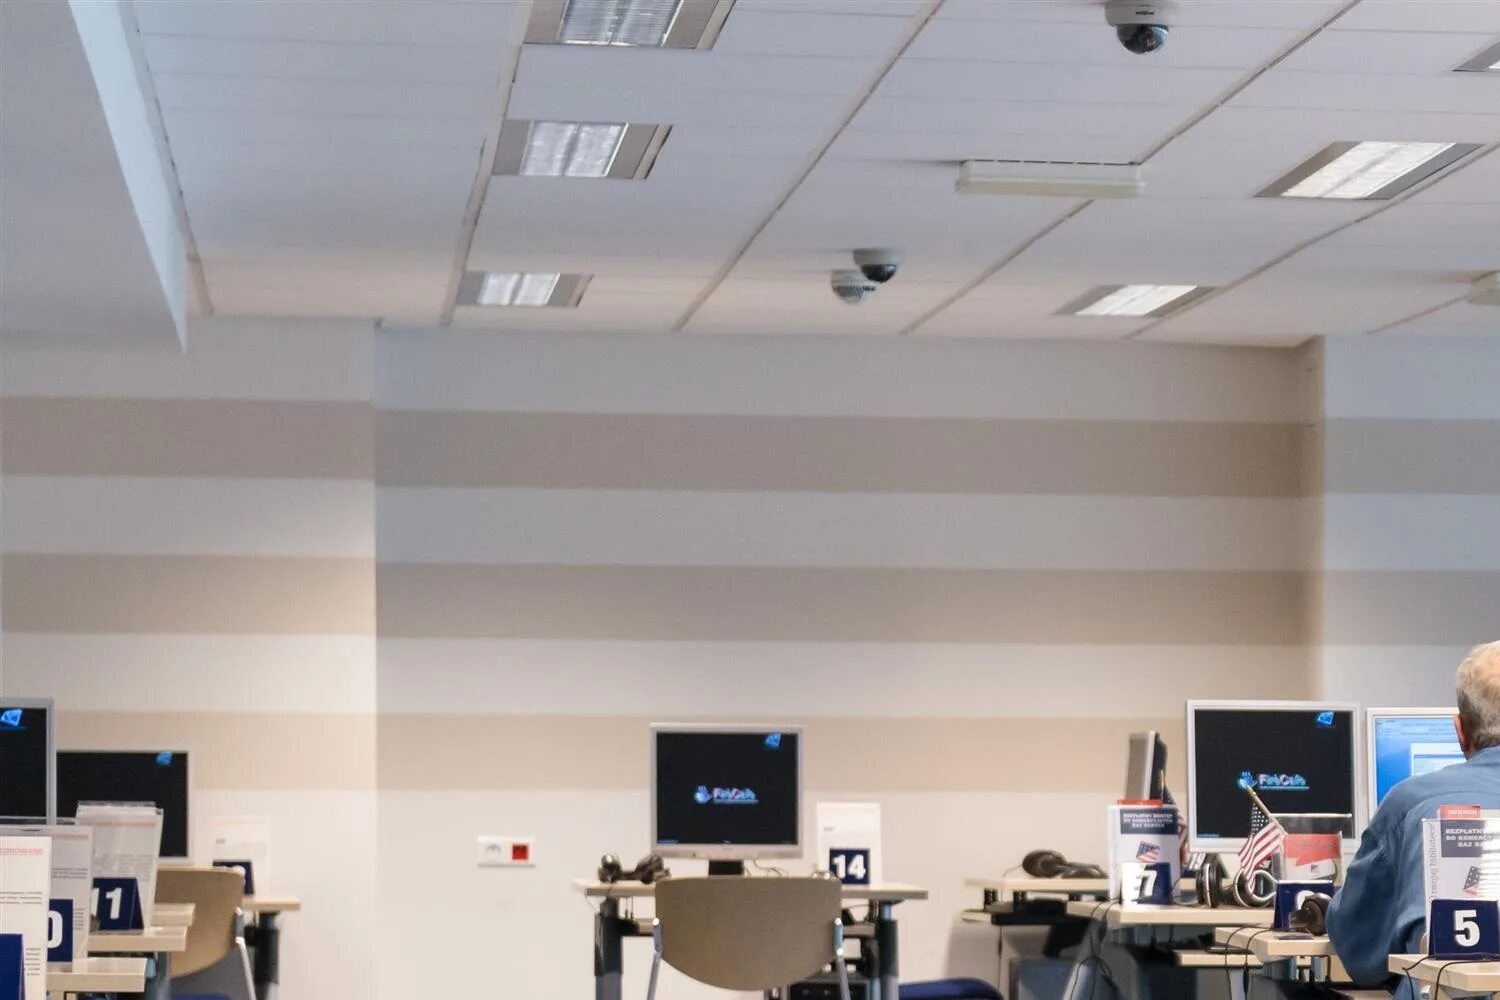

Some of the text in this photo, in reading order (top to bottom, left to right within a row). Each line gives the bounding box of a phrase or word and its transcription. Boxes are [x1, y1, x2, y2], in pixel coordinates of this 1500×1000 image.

[833, 854, 866, 879] 14
[1139, 870, 1157, 896] 7
[1454, 909, 1480, 947] 5
